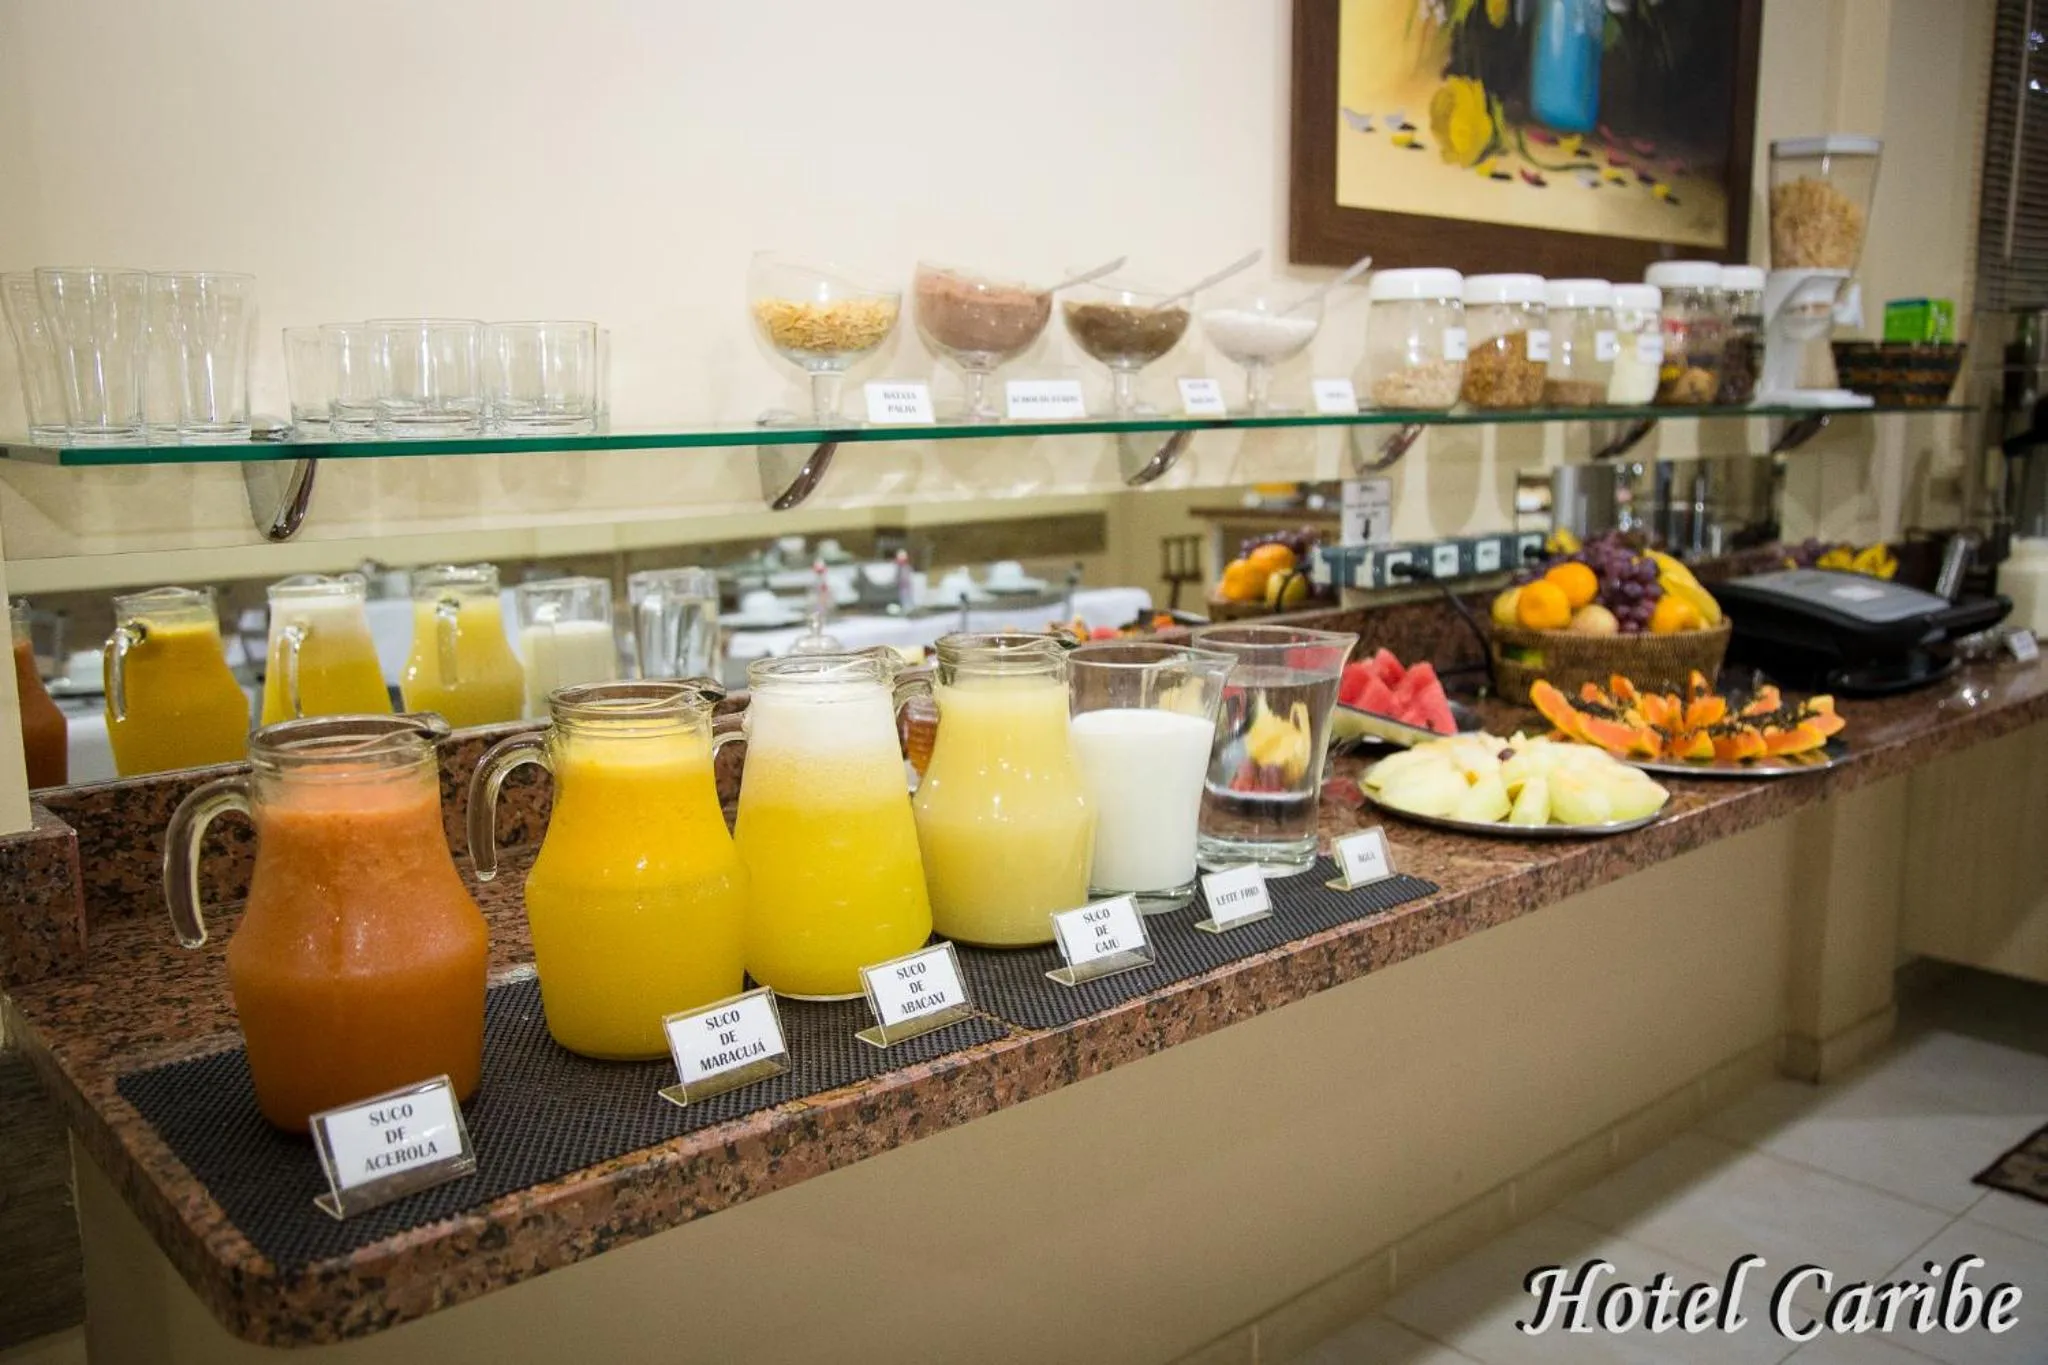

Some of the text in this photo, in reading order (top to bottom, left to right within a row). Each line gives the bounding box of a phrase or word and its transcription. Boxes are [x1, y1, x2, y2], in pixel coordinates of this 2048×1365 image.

[1082, 908, 1111, 924] SUCO
[1095, 924, 1109, 937] DE
[1095, 938, 1120, 954] CAJU
[896, 962, 927, 980] SUCO
[909, 980, 926, 994] DE
[901, 991, 946, 1015] ABACAXI
[705, 1010, 741, 1031] SUCO
[720, 1030, 739, 1046] DE
[369, 1103, 414, 1127] SUCO
[385, 1126, 408, 1145] DE
[364, 1141, 438, 1173] ACEROLA
